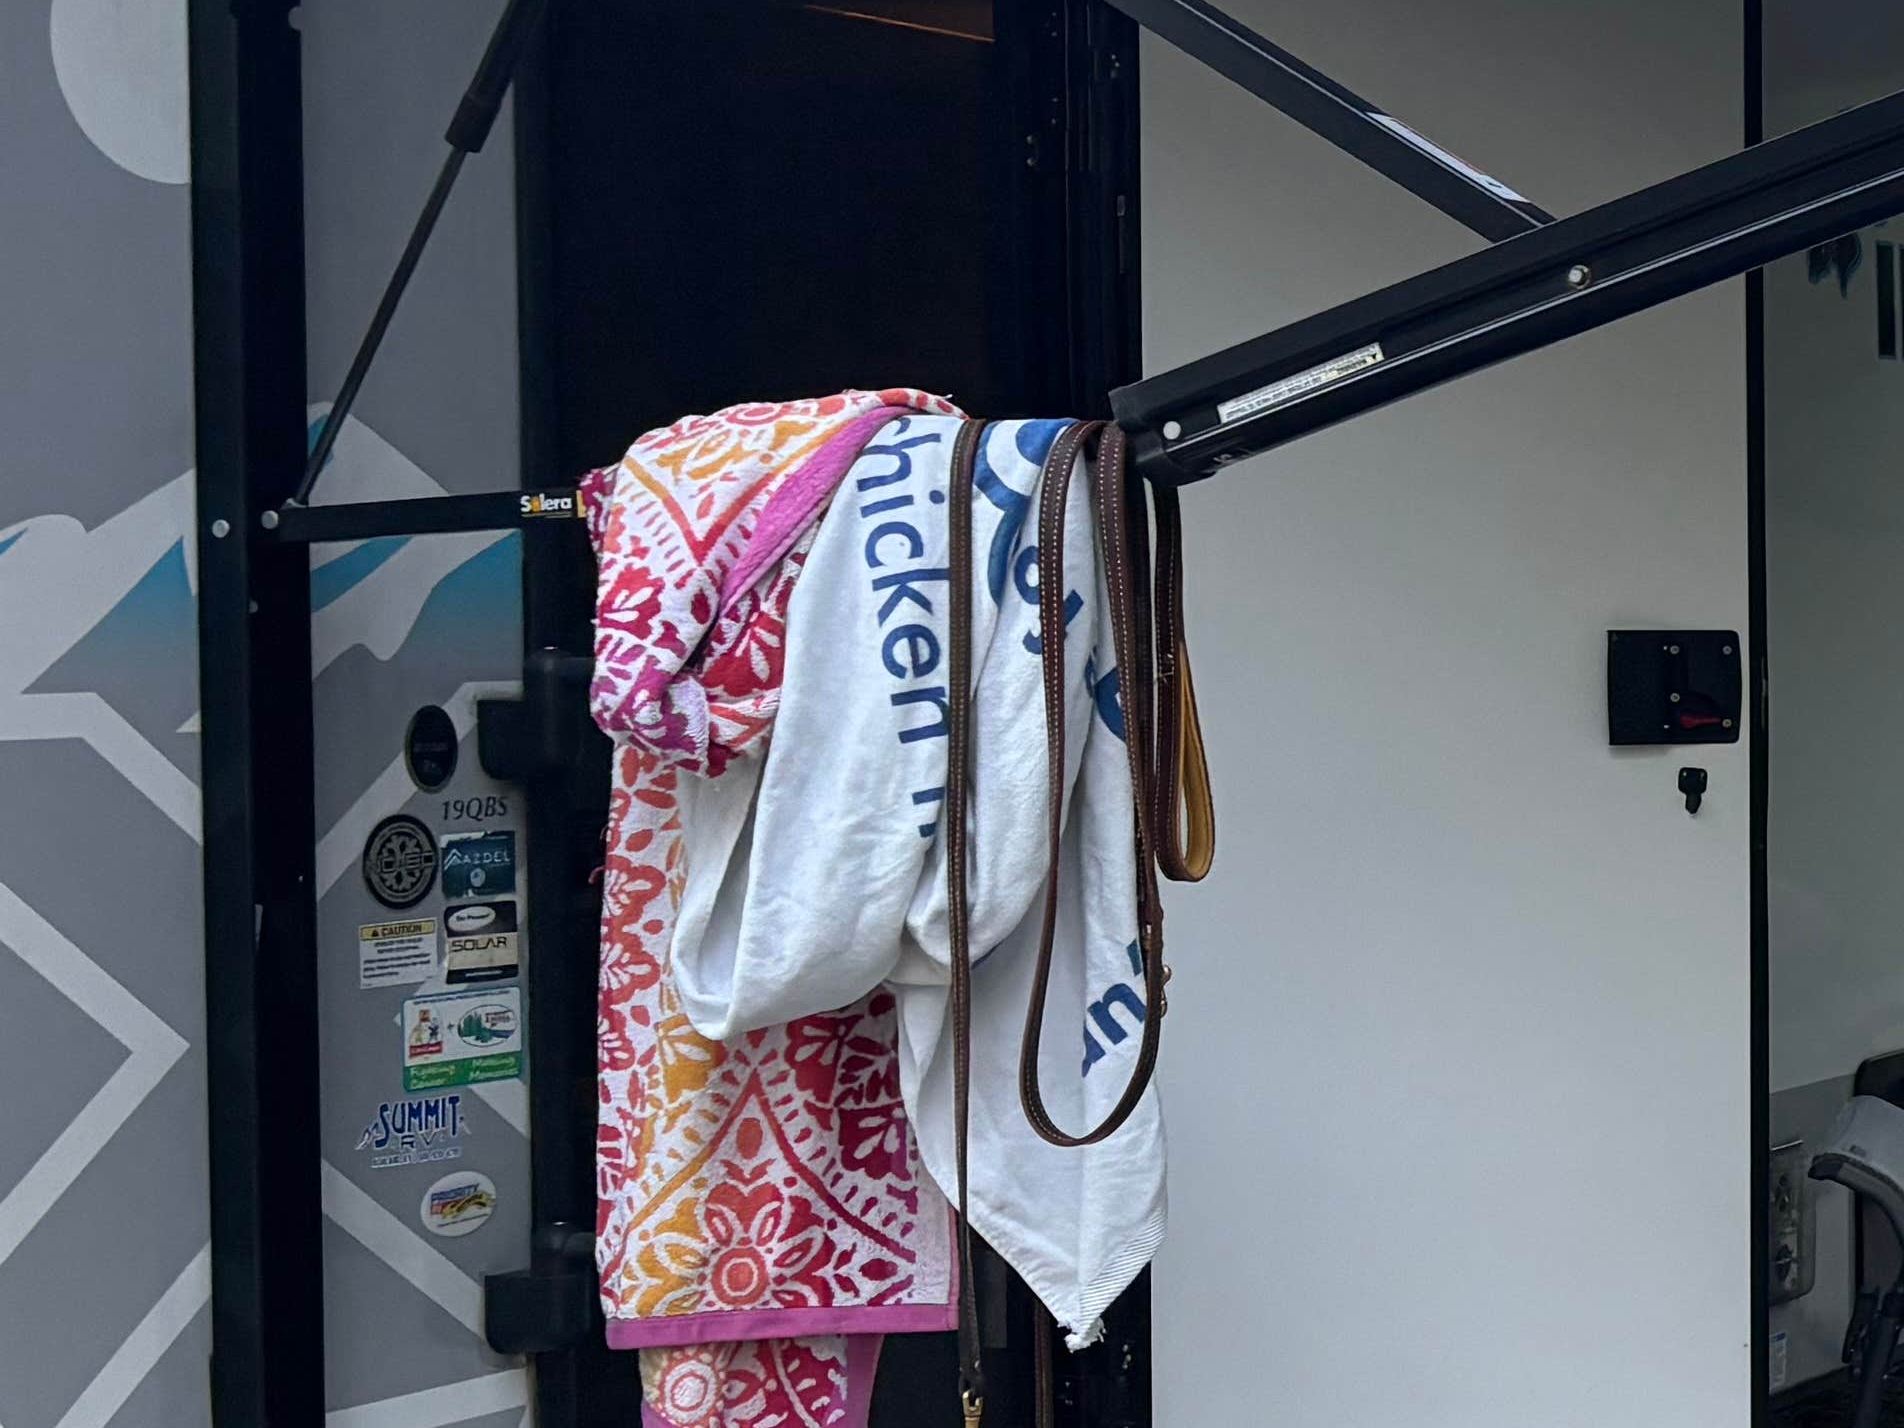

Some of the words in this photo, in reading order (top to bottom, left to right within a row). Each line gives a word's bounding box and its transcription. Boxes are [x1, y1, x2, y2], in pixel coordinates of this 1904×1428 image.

[520, 493, 572, 514] Solera
[442, 796, 507, 821] 19QBS
[382, 923, 422, 937] CAUTION
[451, 937, 507, 953] SOLAR
[375, 1095, 460, 1148] SUMMIT
